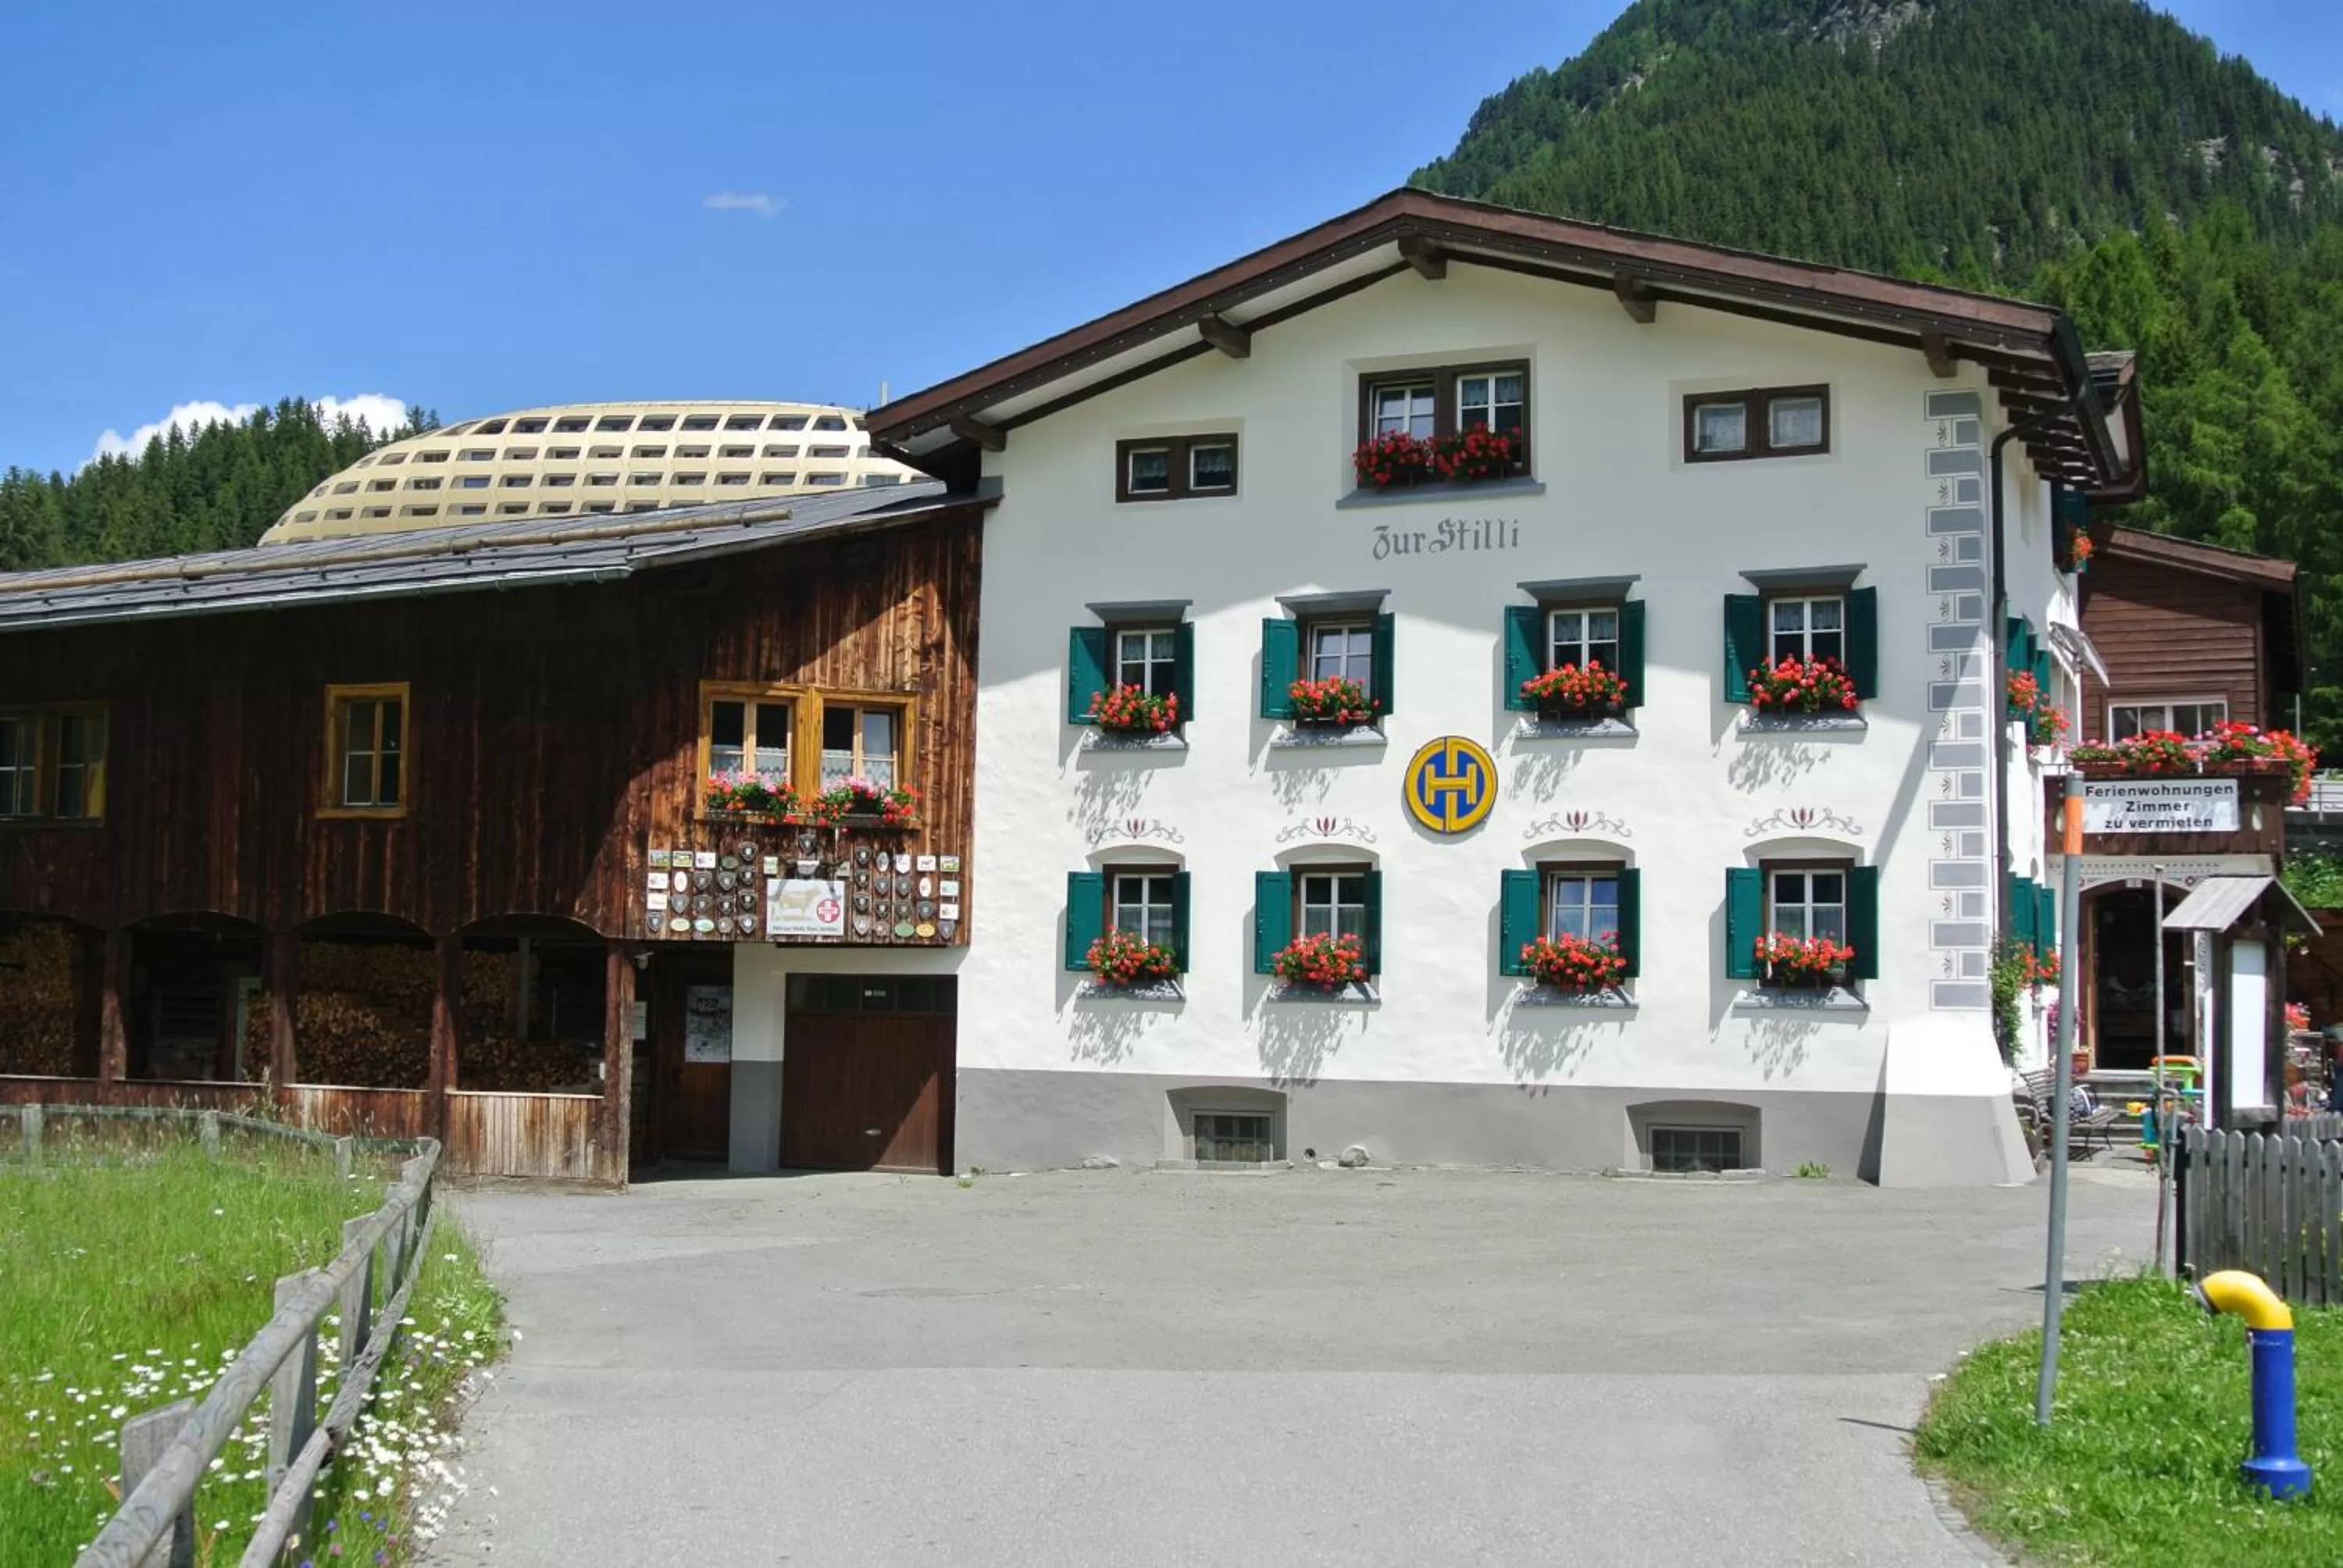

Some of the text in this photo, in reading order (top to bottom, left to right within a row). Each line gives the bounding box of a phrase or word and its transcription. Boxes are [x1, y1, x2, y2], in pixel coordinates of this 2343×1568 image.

[1372, 517, 1519, 561] Zur Stilli
[2084, 784, 2234, 797] Ferienwohnungen
[2126, 800, 2191, 813] Zimmer
[2105, 817, 2213, 829] zu vermieten
